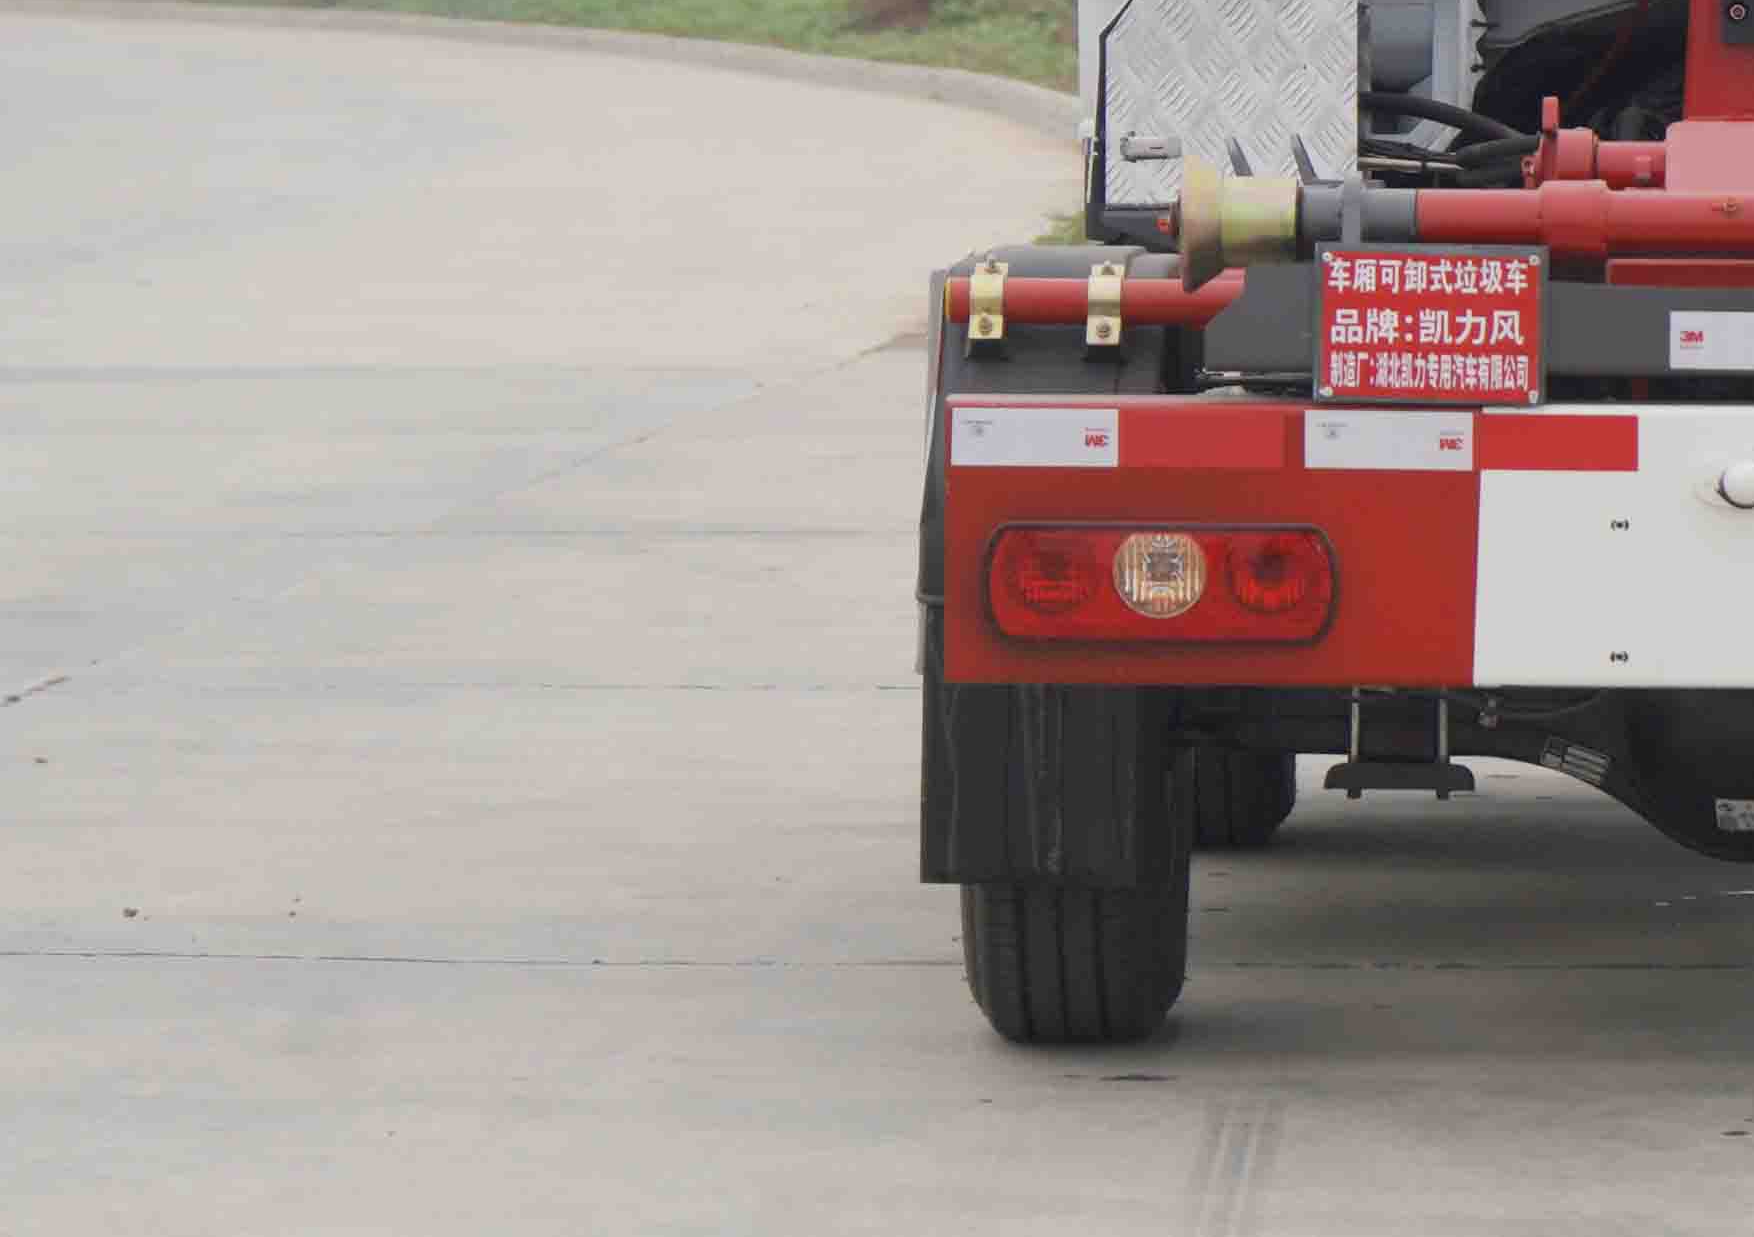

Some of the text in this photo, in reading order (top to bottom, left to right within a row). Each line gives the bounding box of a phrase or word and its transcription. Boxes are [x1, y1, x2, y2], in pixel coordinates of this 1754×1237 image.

[1328, 259, 1528, 294] 车厢可卸式垃圾车
[1680, 331, 1704, 343] 3M
[1085, 435, 1110, 447] 3M
